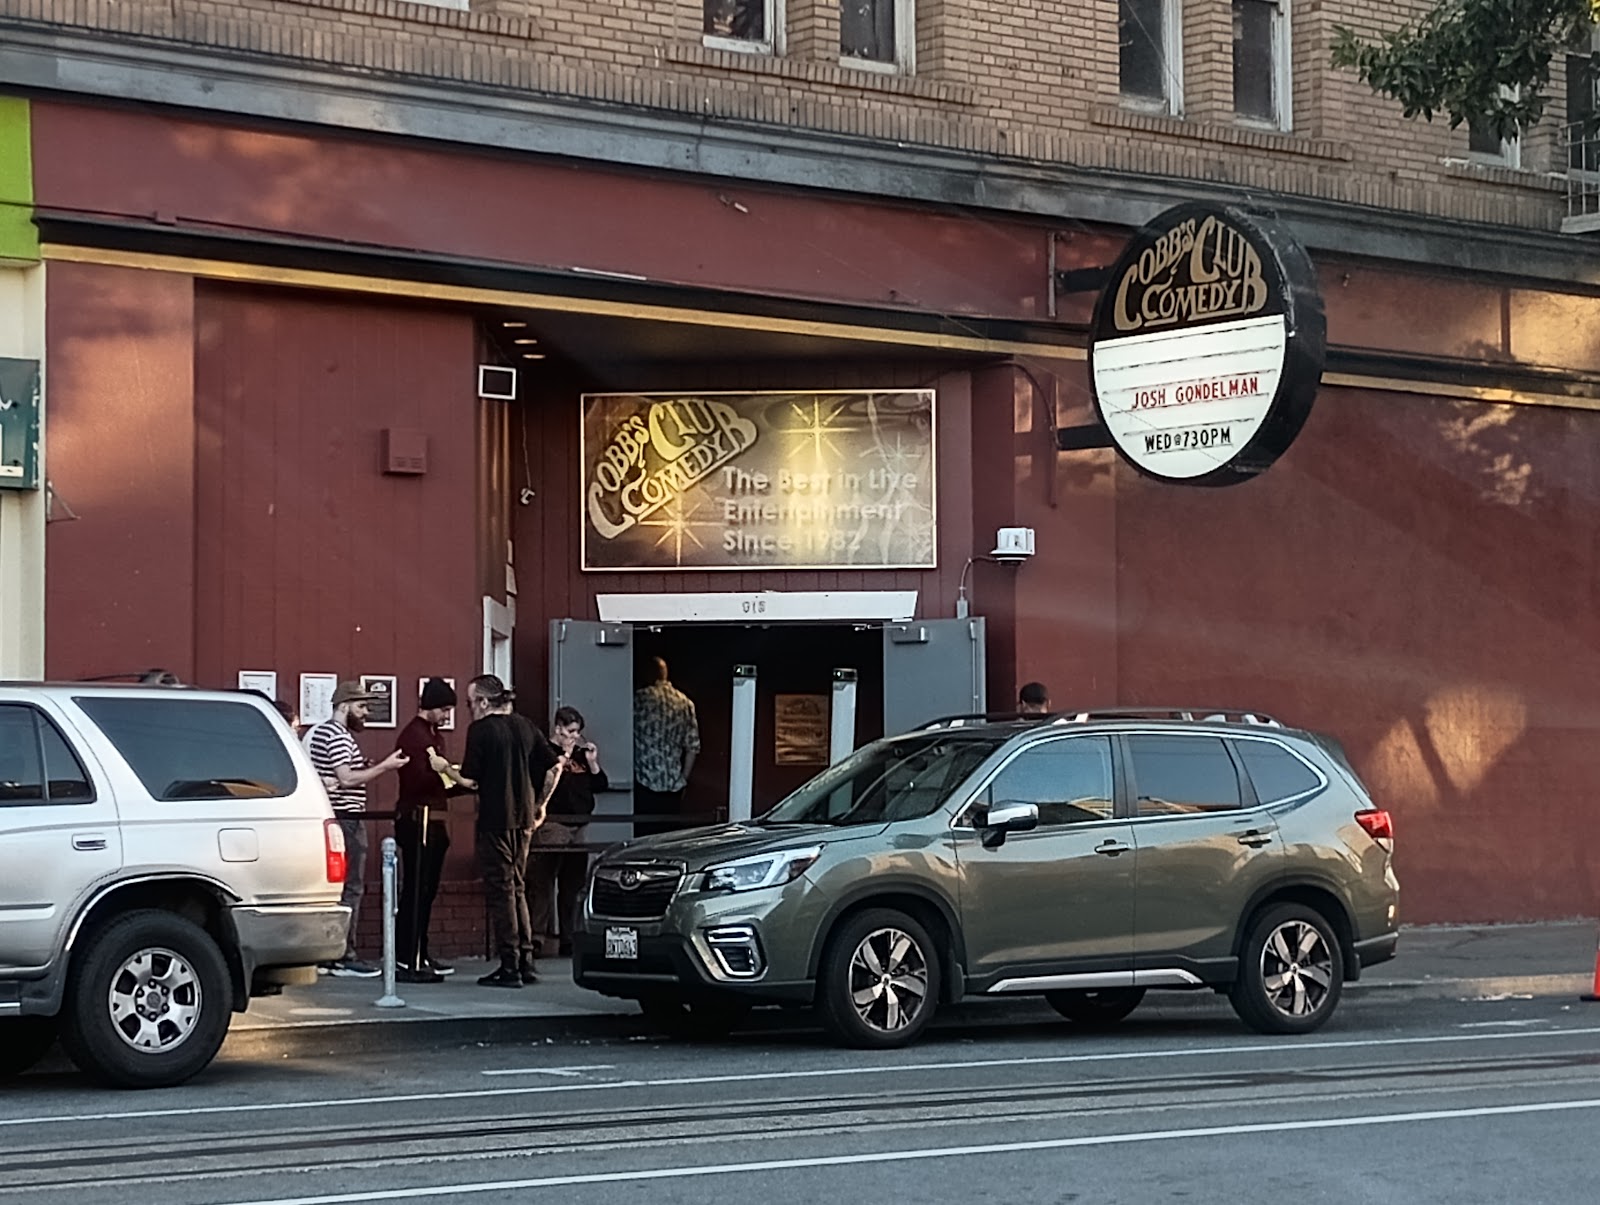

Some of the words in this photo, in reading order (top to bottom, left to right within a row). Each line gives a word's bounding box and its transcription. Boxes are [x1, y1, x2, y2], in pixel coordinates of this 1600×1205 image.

[1114, 218, 1195, 331] COBB'S
[1190, 215, 1268, 315] CLUB
[1141, 274, 1241, 327] COMEDY
[1131, 388, 1167, 411] JOSH
[1175, 376, 1259, 404] GONDELMAN
[588, 415, 650, 540] COBB'S
[648, 398, 758, 462] CLUB
[621, 429, 729, 523] COMEDY
[722, 466, 769, 490] The
[839, 468, 860, 490] in
[868, 467, 917, 490] Live
[723, 499, 903, 521] Entertainment
[722, 530, 793, 551] Since
